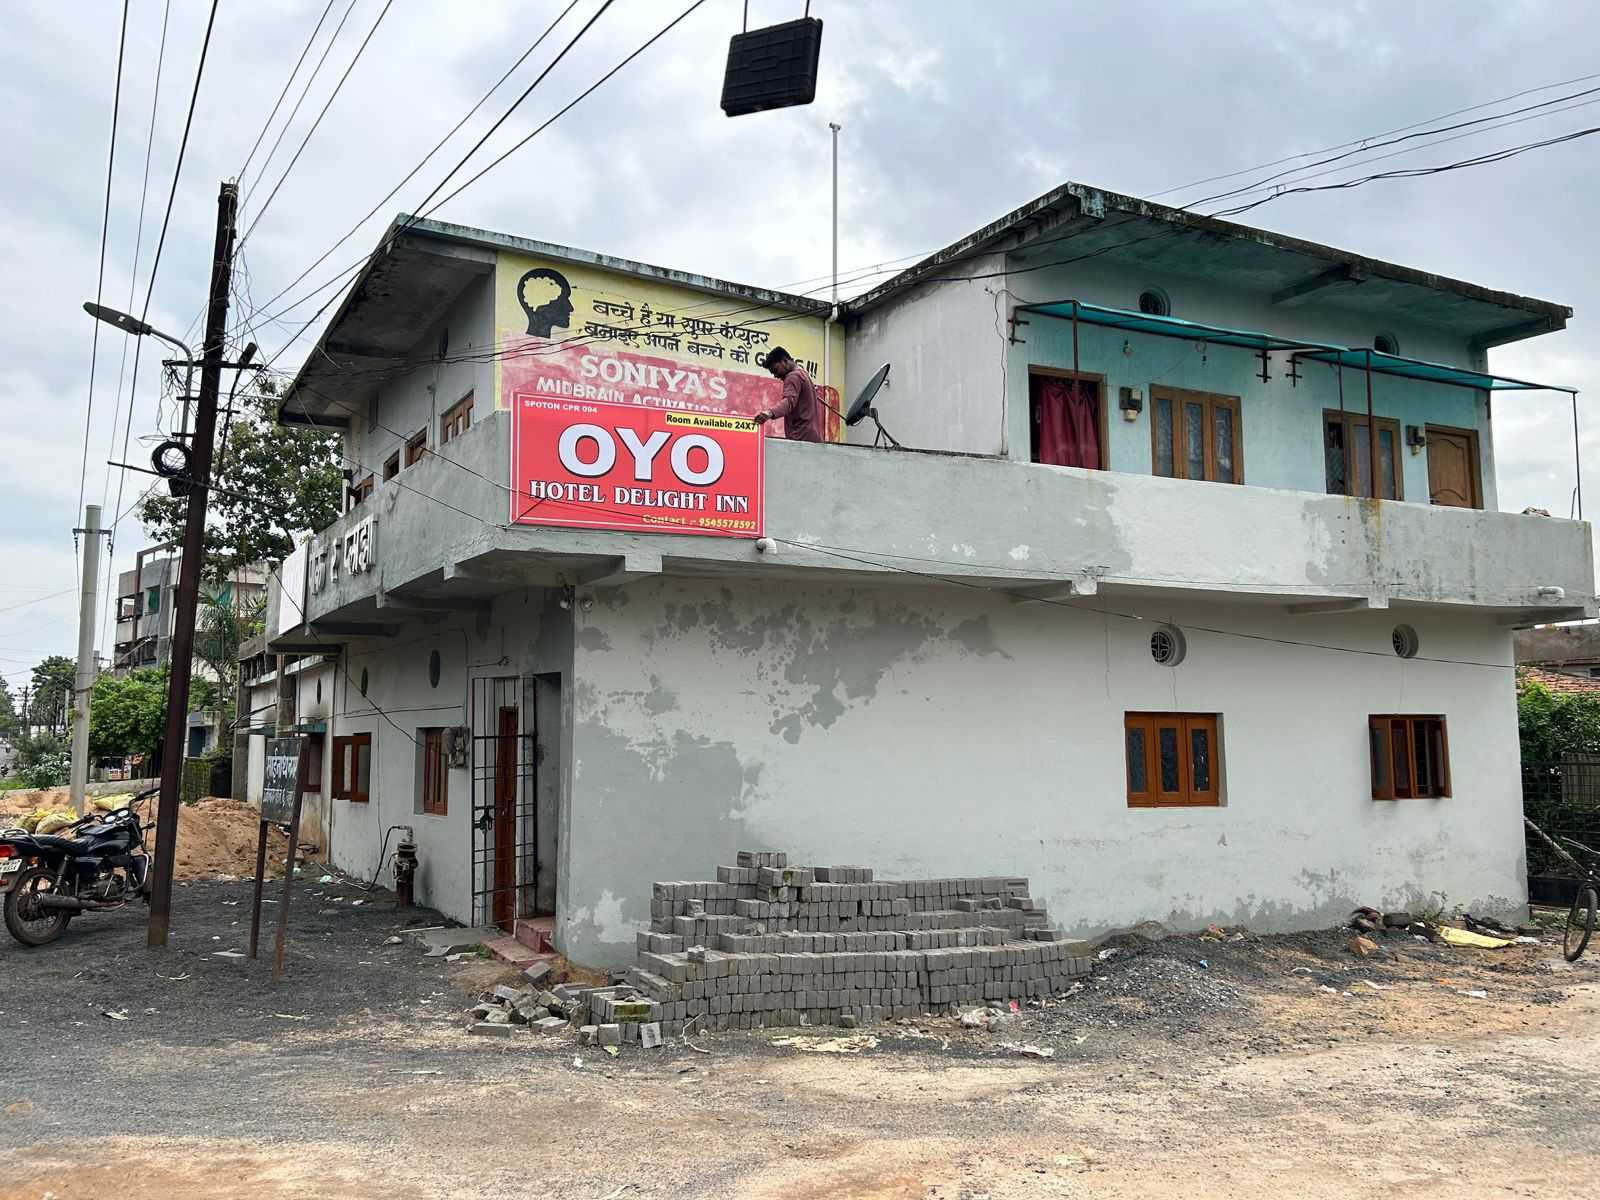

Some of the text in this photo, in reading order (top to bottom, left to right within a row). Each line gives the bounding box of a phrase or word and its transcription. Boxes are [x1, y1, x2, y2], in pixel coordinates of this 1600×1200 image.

[593, 299, 635, 321] बच्चे
[656, 312, 676, 329] या
[687, 341, 725, 359] बच्चे
[730, 345, 751, 365] को
[536, 376, 625, 403] MIDBRAIN
[524, 400, 560, 411] SPOTON
[562, 403, 580, 412] CPR
[666, 414, 756, 431] Room Available 24X7
[558, 423, 725, 487] OYO
[529, 479, 748, 513] HOTEL DELIGHT INN
[643, 514, 685, 525] Contact
